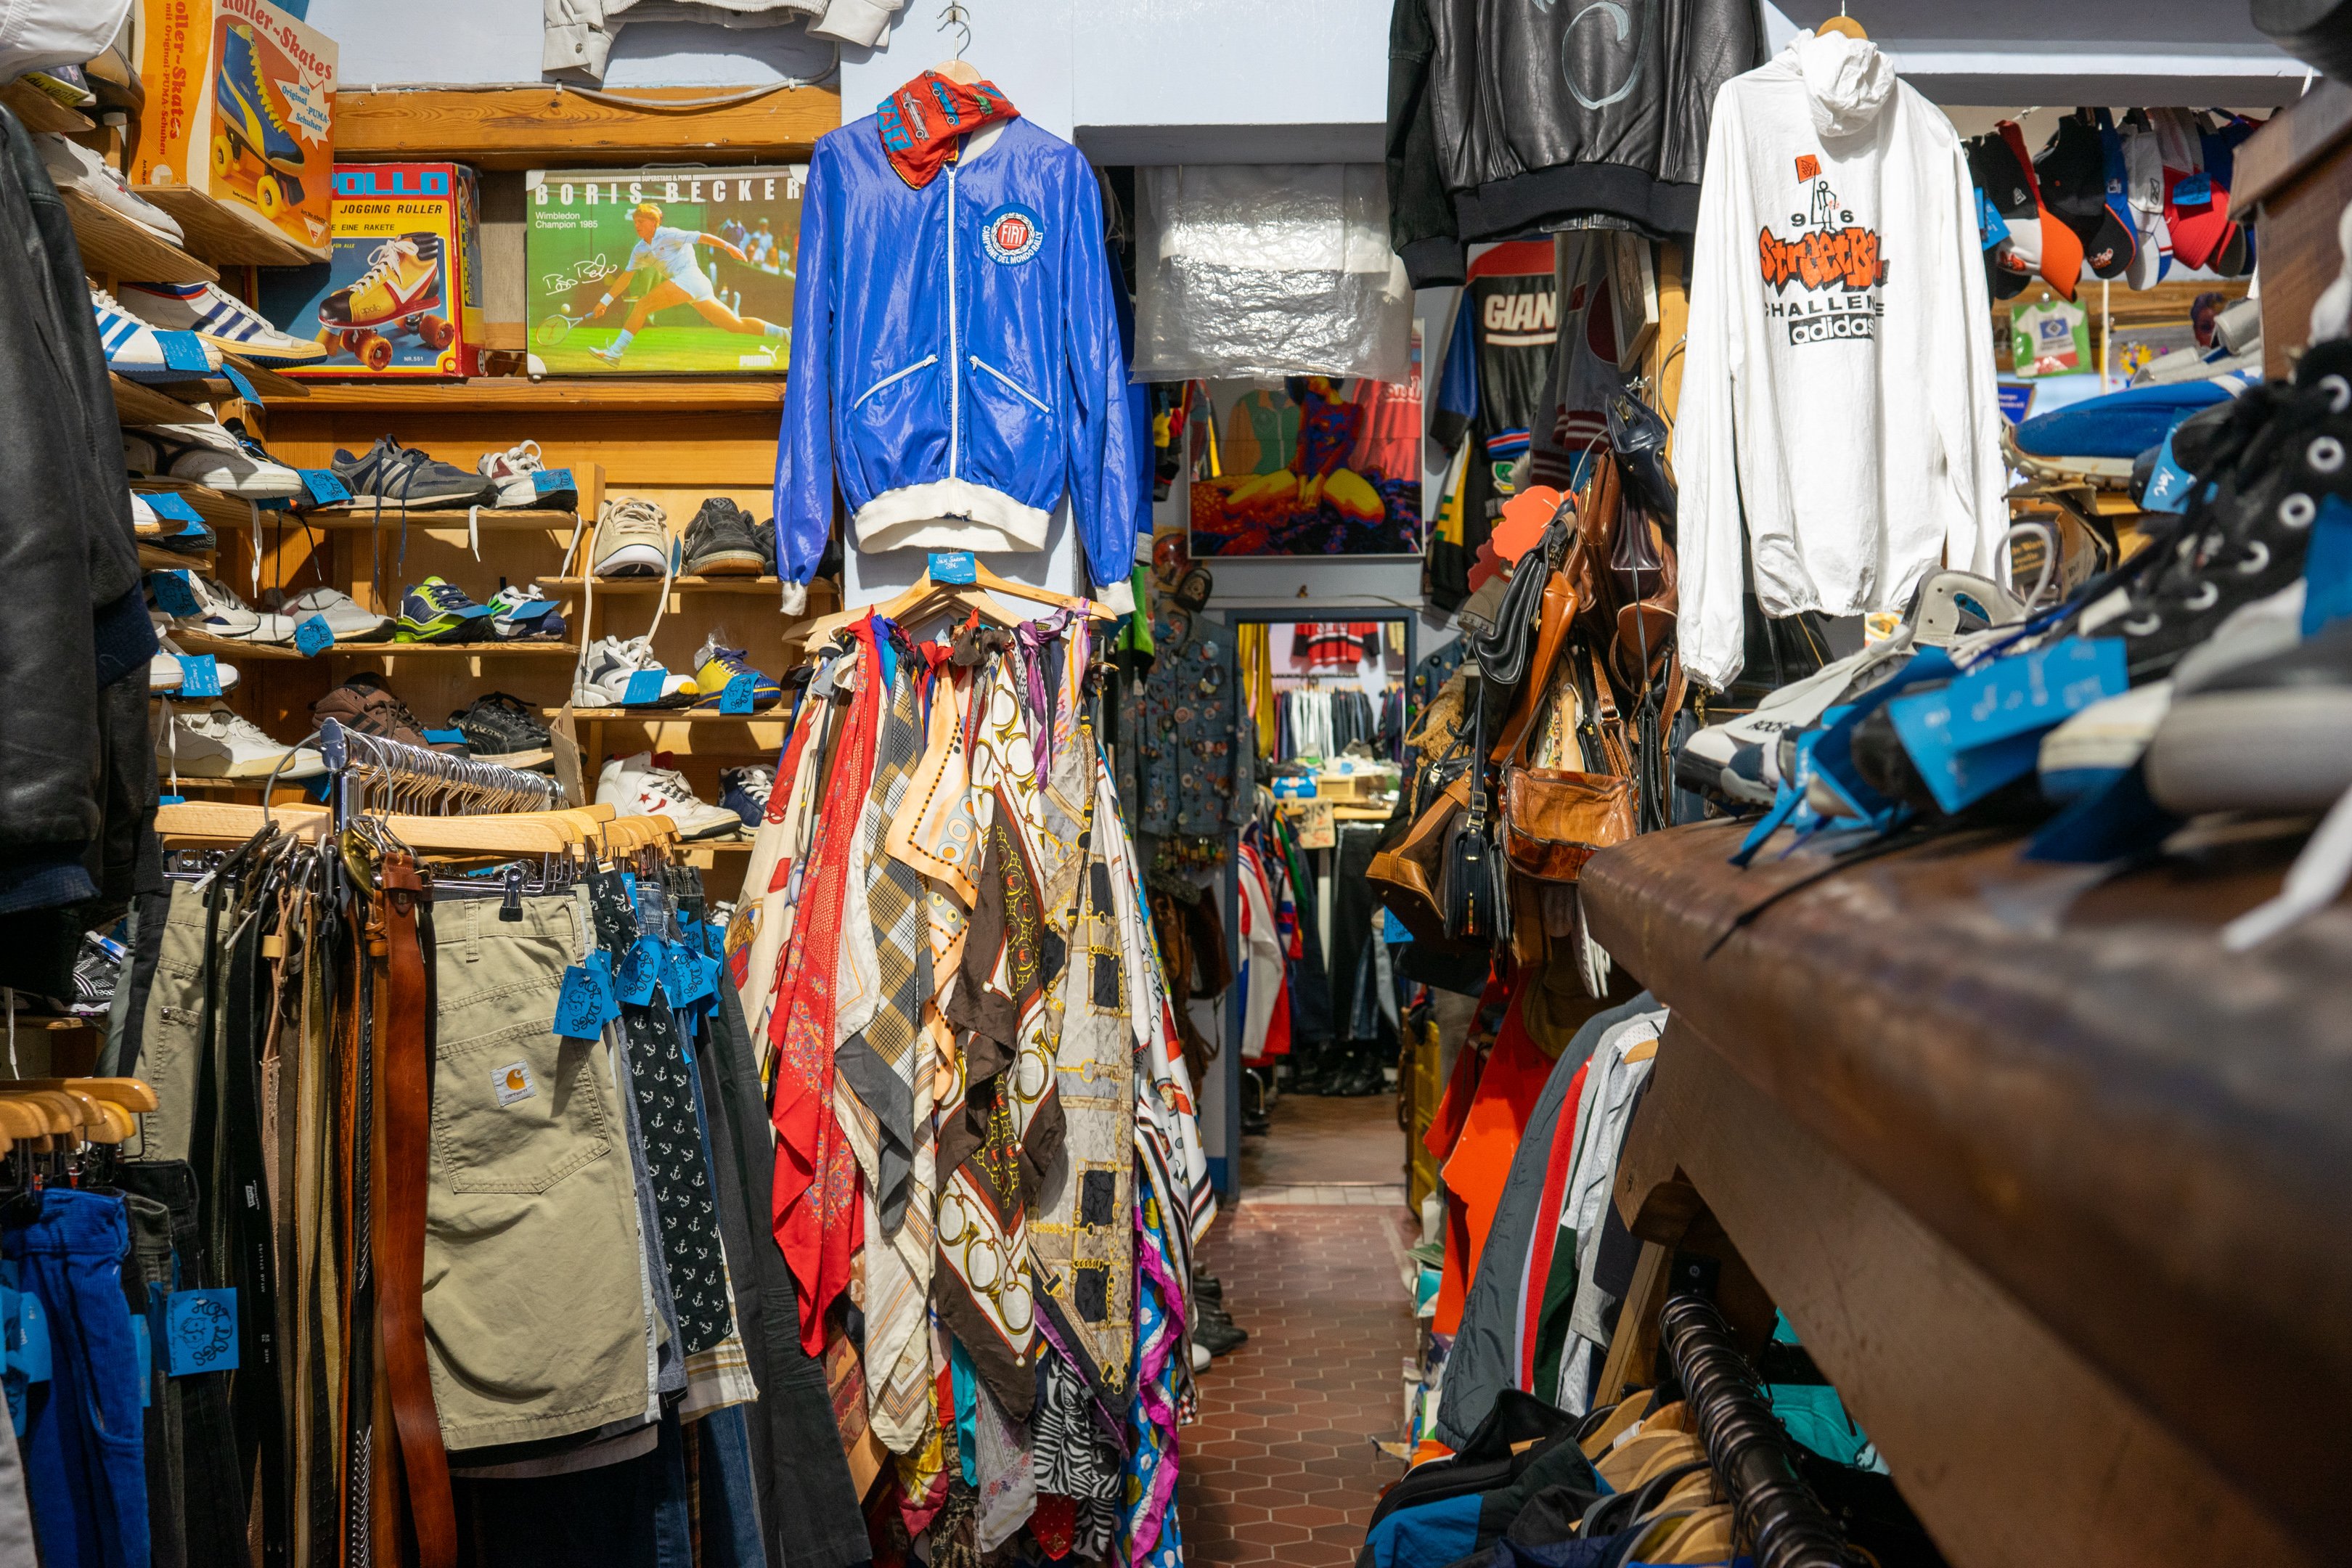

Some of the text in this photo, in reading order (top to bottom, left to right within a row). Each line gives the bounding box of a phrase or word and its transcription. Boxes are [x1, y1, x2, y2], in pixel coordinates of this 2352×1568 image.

[282, 85, 308, 105] Original
[299, 84, 310, 95] mit
[295, 113, 322, 132] Schuhen
[332, 172, 449, 195] OLLO
[535, 178, 800, 205] BORIS BECKER
[340, 204, 443, 214] JOGGING ROLLER
[535, 211, 580, 220] Wimbledon
[535, 220, 597, 229] Champion 1985
[1001, 224, 1026, 245] FIAT
[981, 225, 1043, 264] CAMPIONE DEL MONDO RALLY
[360, 304, 381, 317] apollo
[1792, 315, 1875, 344] adidas
